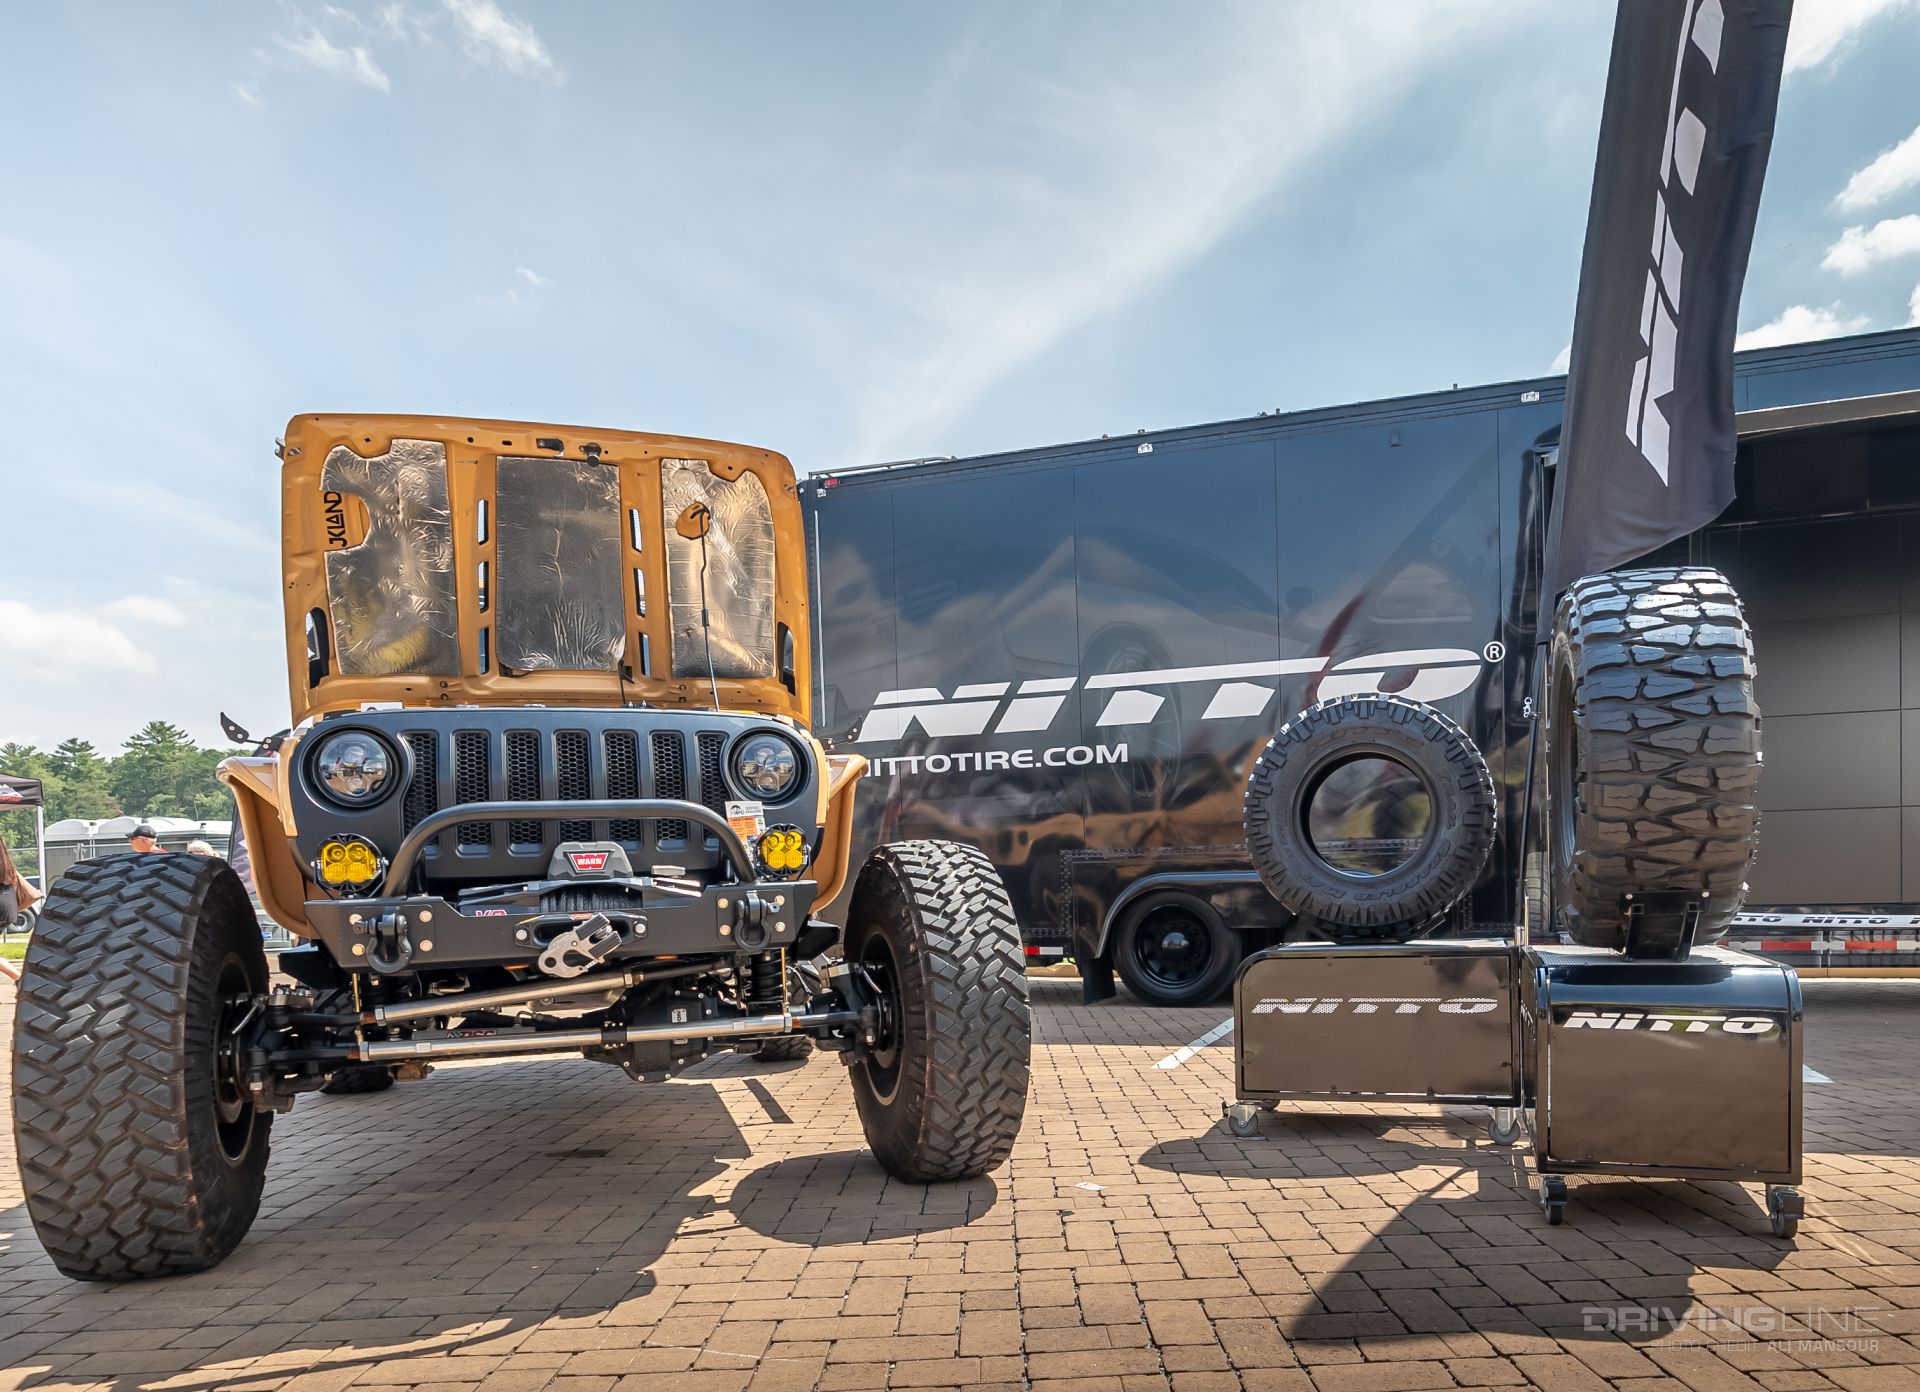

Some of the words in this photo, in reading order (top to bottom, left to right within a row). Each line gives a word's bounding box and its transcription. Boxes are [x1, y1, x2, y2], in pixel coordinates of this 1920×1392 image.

[854, 648, 1482, 743] NITTO
[576, 857, 603, 866] WARN
[1801, 916, 1890, 925] NITTO
[1251, 997, 1498, 1014] NITTO
[1562, 1012, 1775, 1034] NITTO
